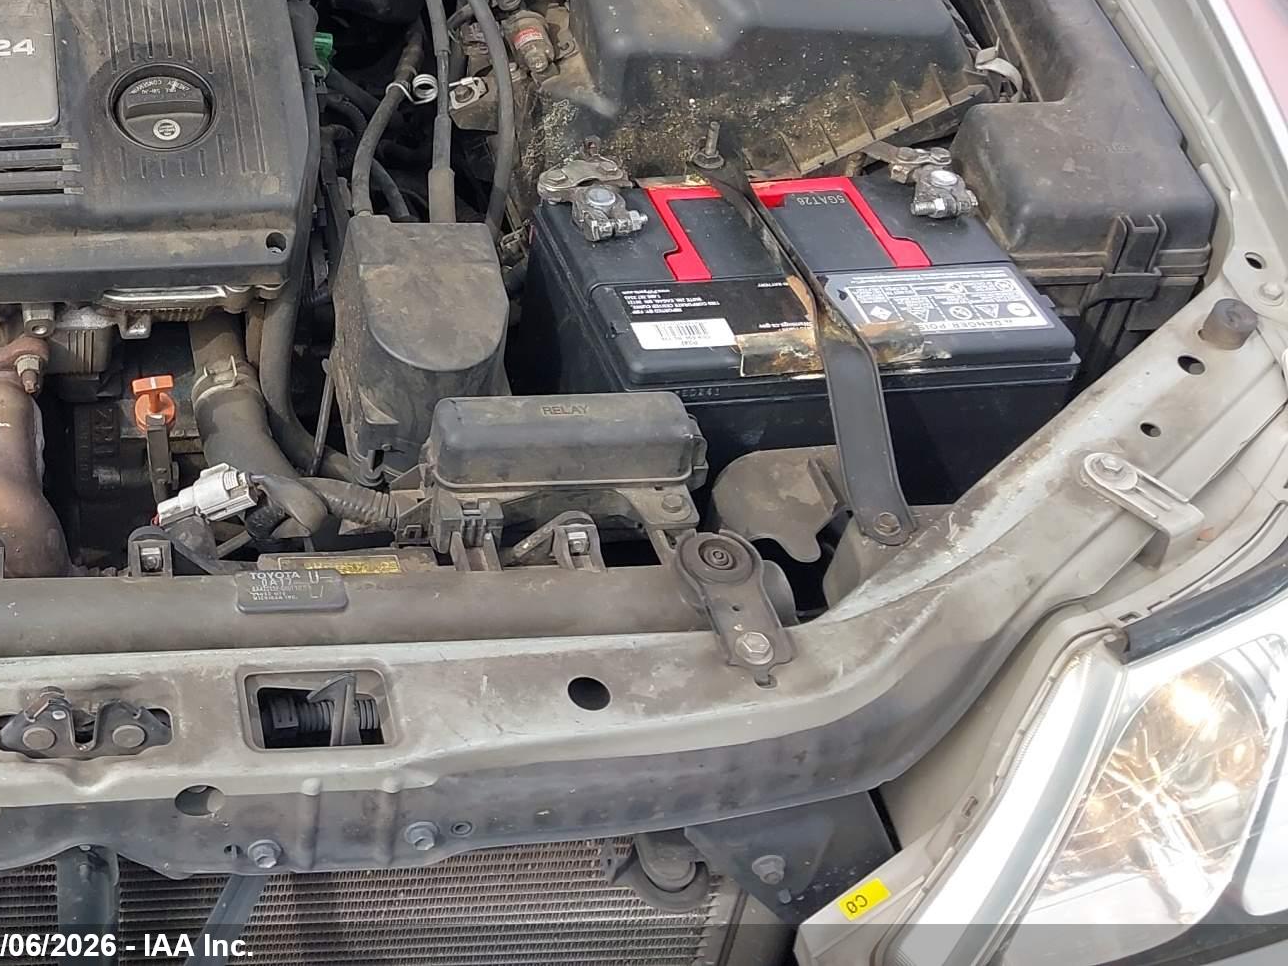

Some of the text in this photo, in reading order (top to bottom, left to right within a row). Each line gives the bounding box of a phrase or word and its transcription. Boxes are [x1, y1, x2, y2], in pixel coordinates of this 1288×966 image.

[918, 323, 946, 331] POIS
[542, 404, 588, 416] RELAY
[249, 571, 301, 580] TOYOTA
